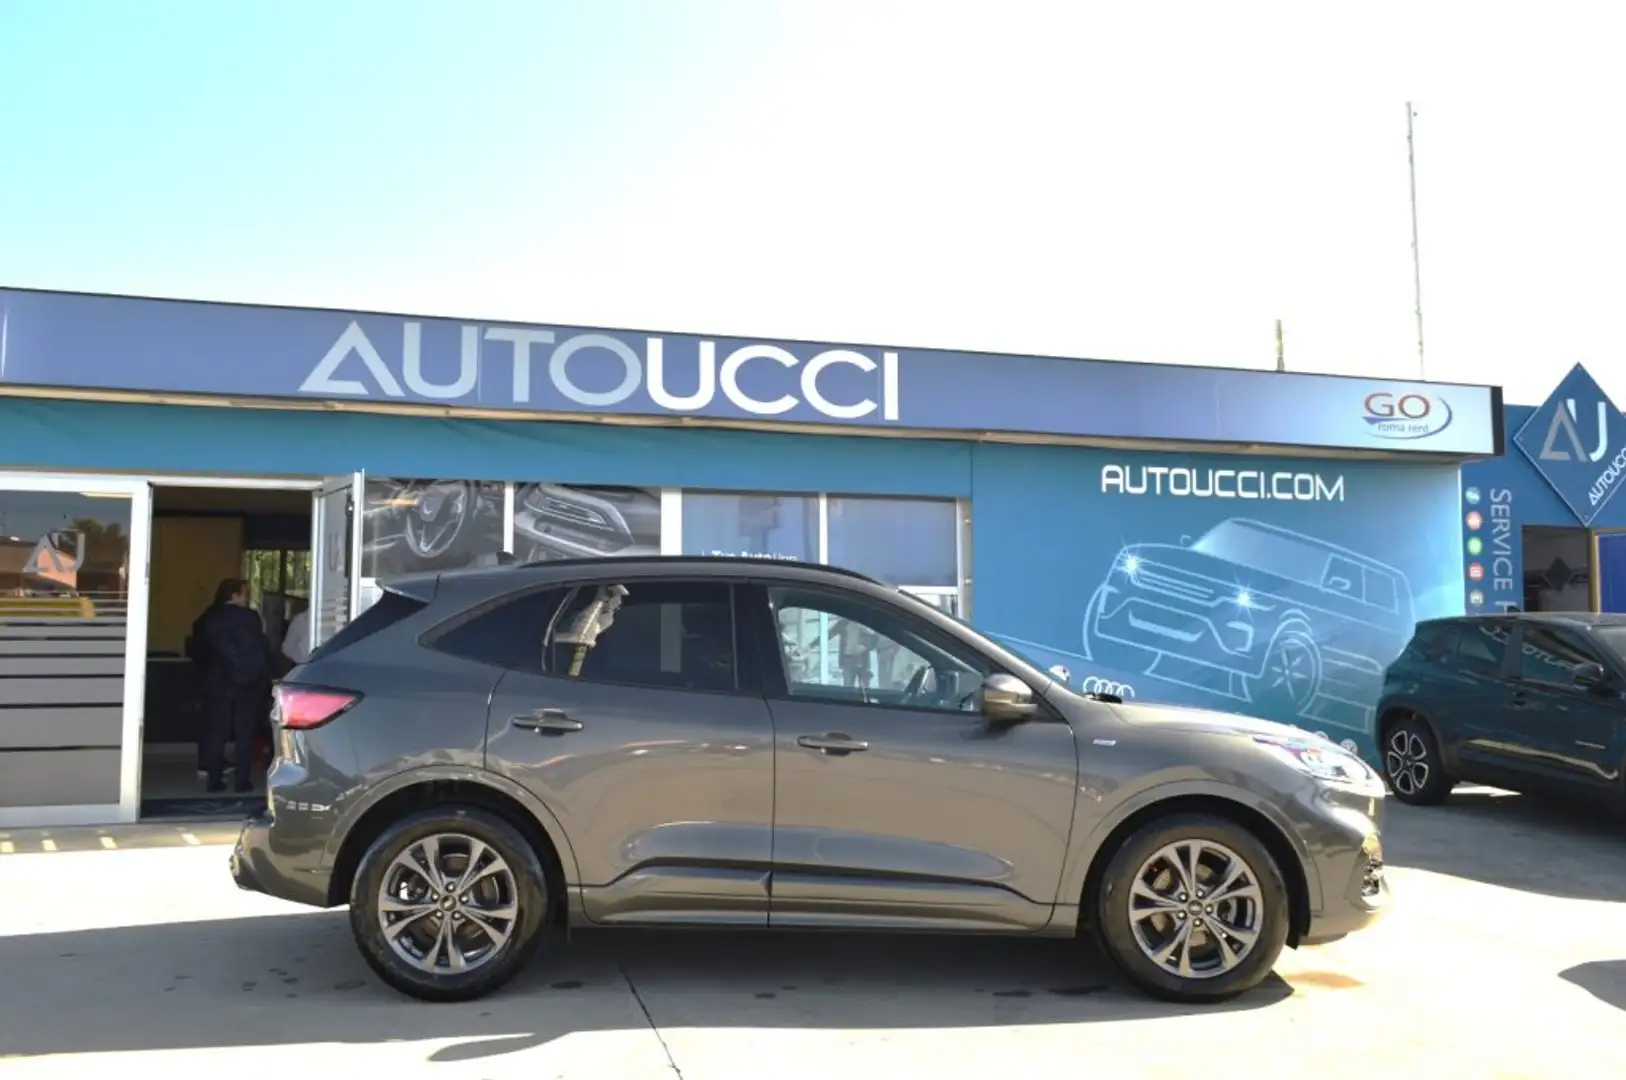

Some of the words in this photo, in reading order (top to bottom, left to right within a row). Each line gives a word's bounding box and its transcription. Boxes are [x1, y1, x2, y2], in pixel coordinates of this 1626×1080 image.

[298, 319, 899, 421] AUTOUCCI
[1364, 392, 1430, 419] GO
[1101, 464, 1345, 502] AUTOUCCI.COM
[1489, 488, 1513, 592] SERVICE
